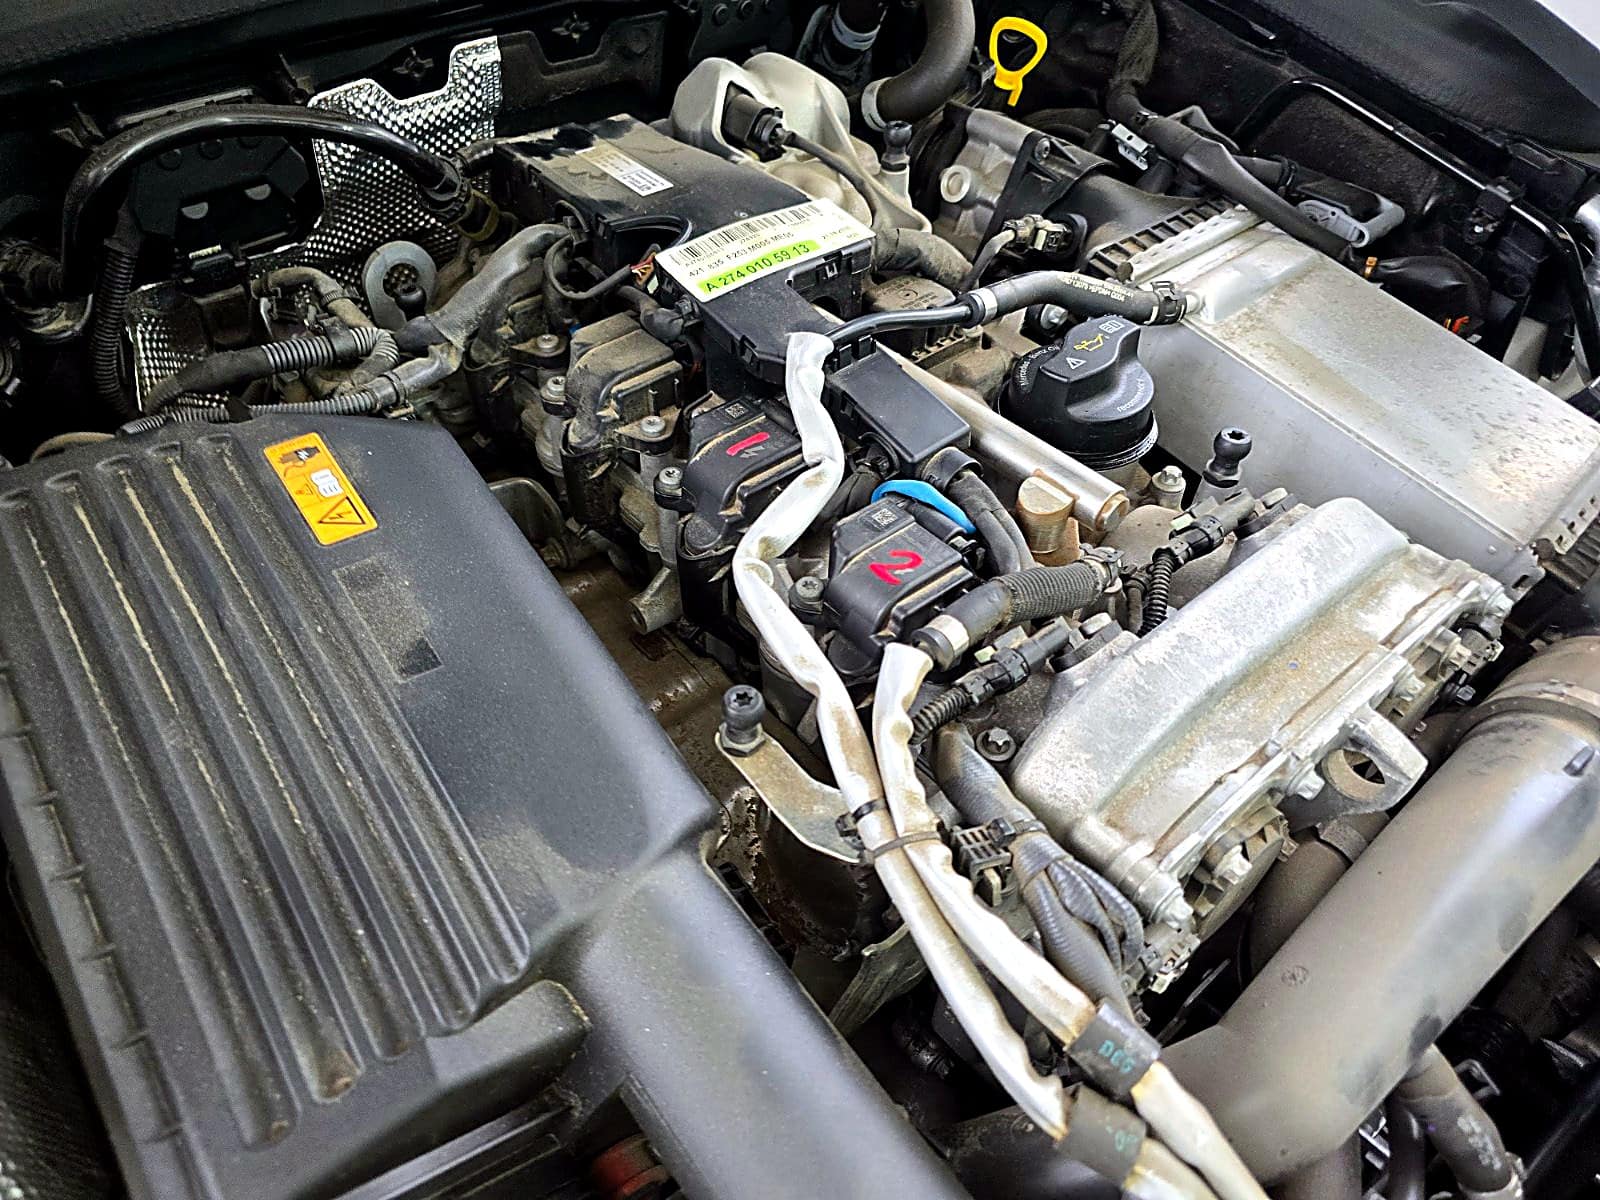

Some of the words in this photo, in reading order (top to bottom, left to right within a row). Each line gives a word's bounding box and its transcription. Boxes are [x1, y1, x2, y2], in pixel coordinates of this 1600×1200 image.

[706, 282, 719, 292] A
[718, 271, 746, 286] 274
[746, 257, 773, 274] 010
[773, 250, 791, 263] 59
[792, 244, 810, 256] 13
[869, 550, 924, 585] 2
